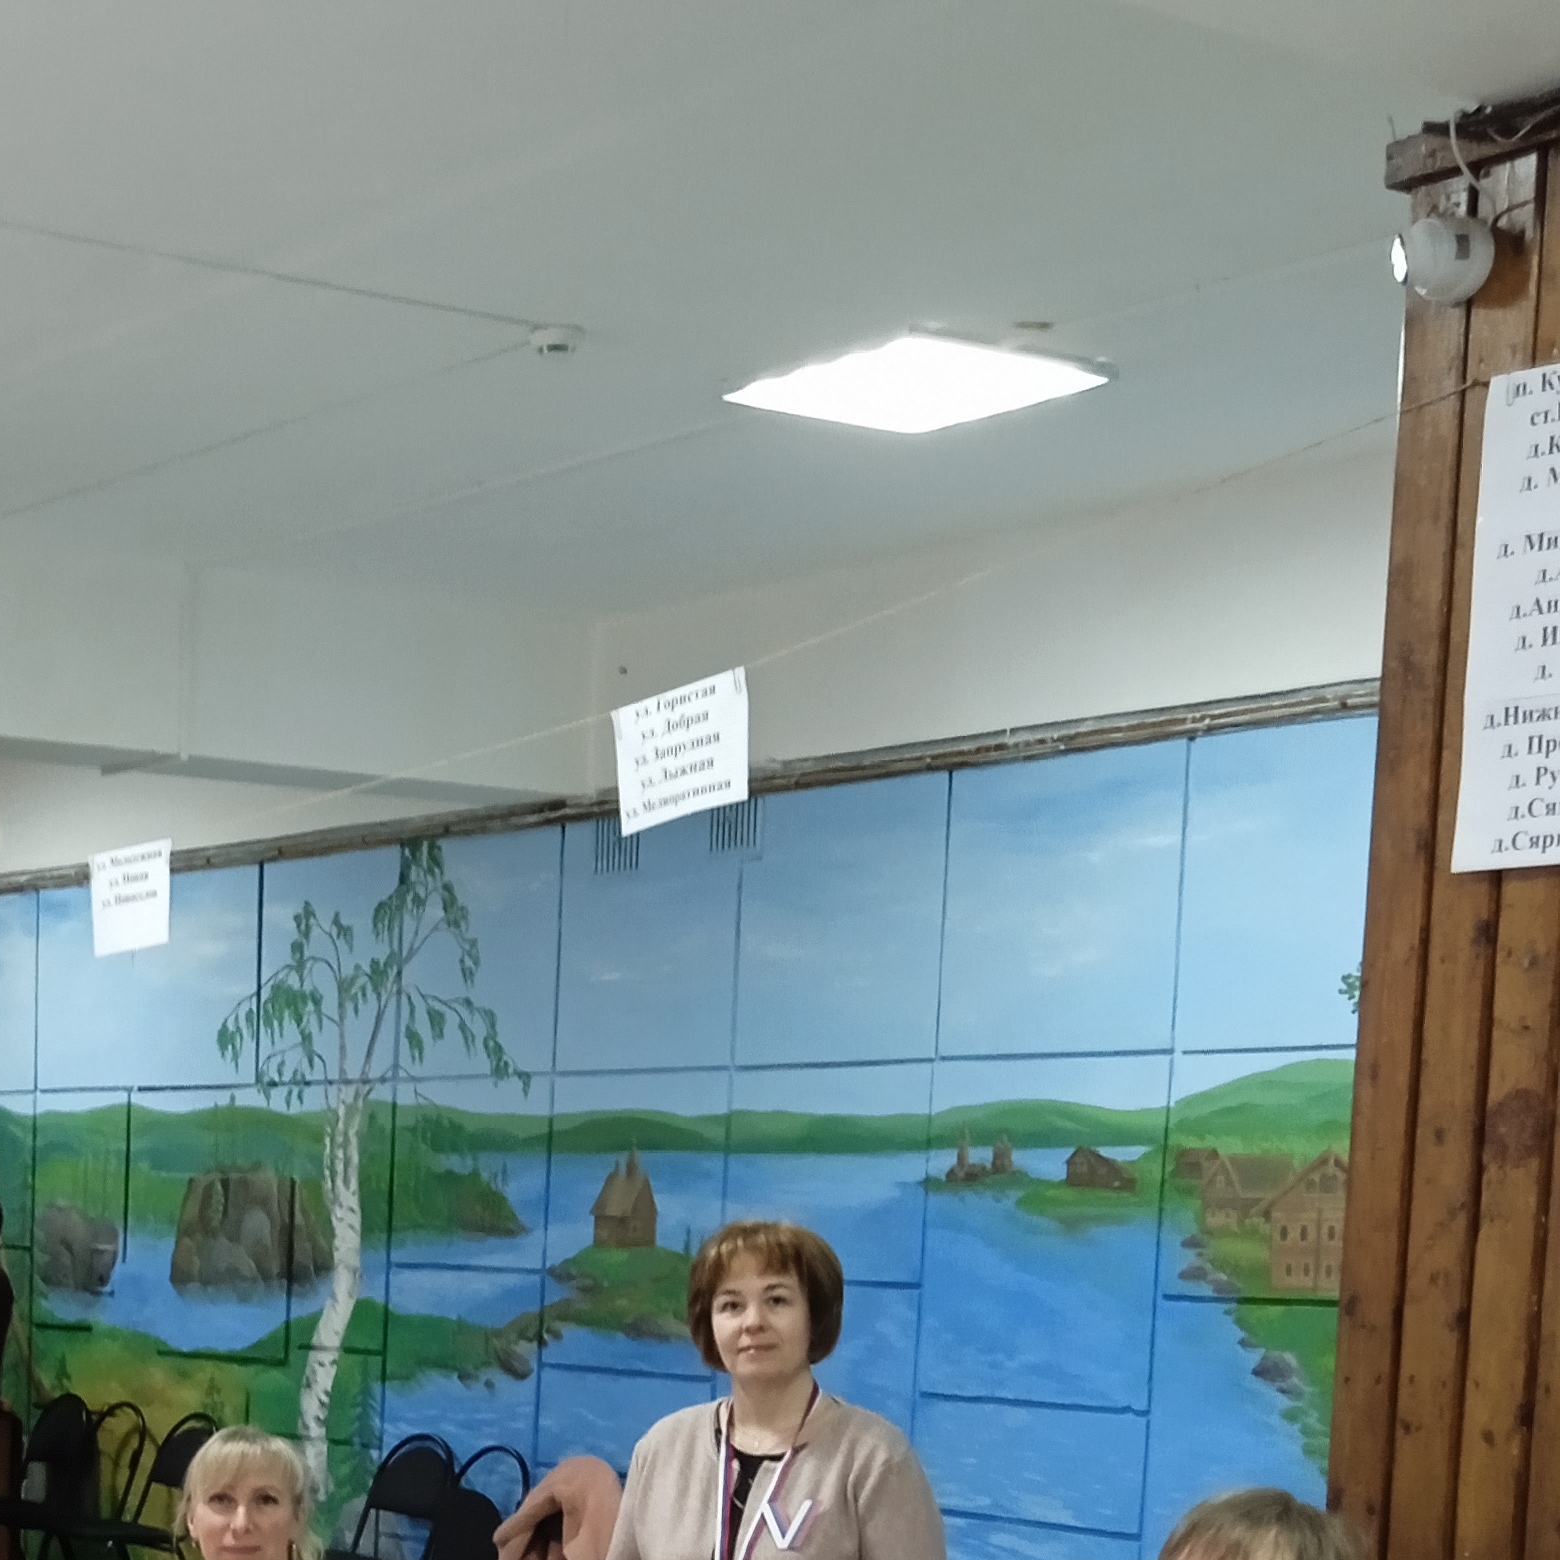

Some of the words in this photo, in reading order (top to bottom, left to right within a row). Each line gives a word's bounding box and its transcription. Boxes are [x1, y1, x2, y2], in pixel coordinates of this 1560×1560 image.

[1530, 402, 1560, 427] ст.
[1520, 475, 1538, 493] д.
[1497, 543, 1515, 560] д.
[1534, 568, 1560, 586] д.
[1514, 635, 1533, 653] д.
[1500, 743, 1518, 760] д.
[1527, 734, 1560, 759] Пр
[1507, 774, 1526, 791] д.
[1506, 797, 1560, 822] д.Ся
